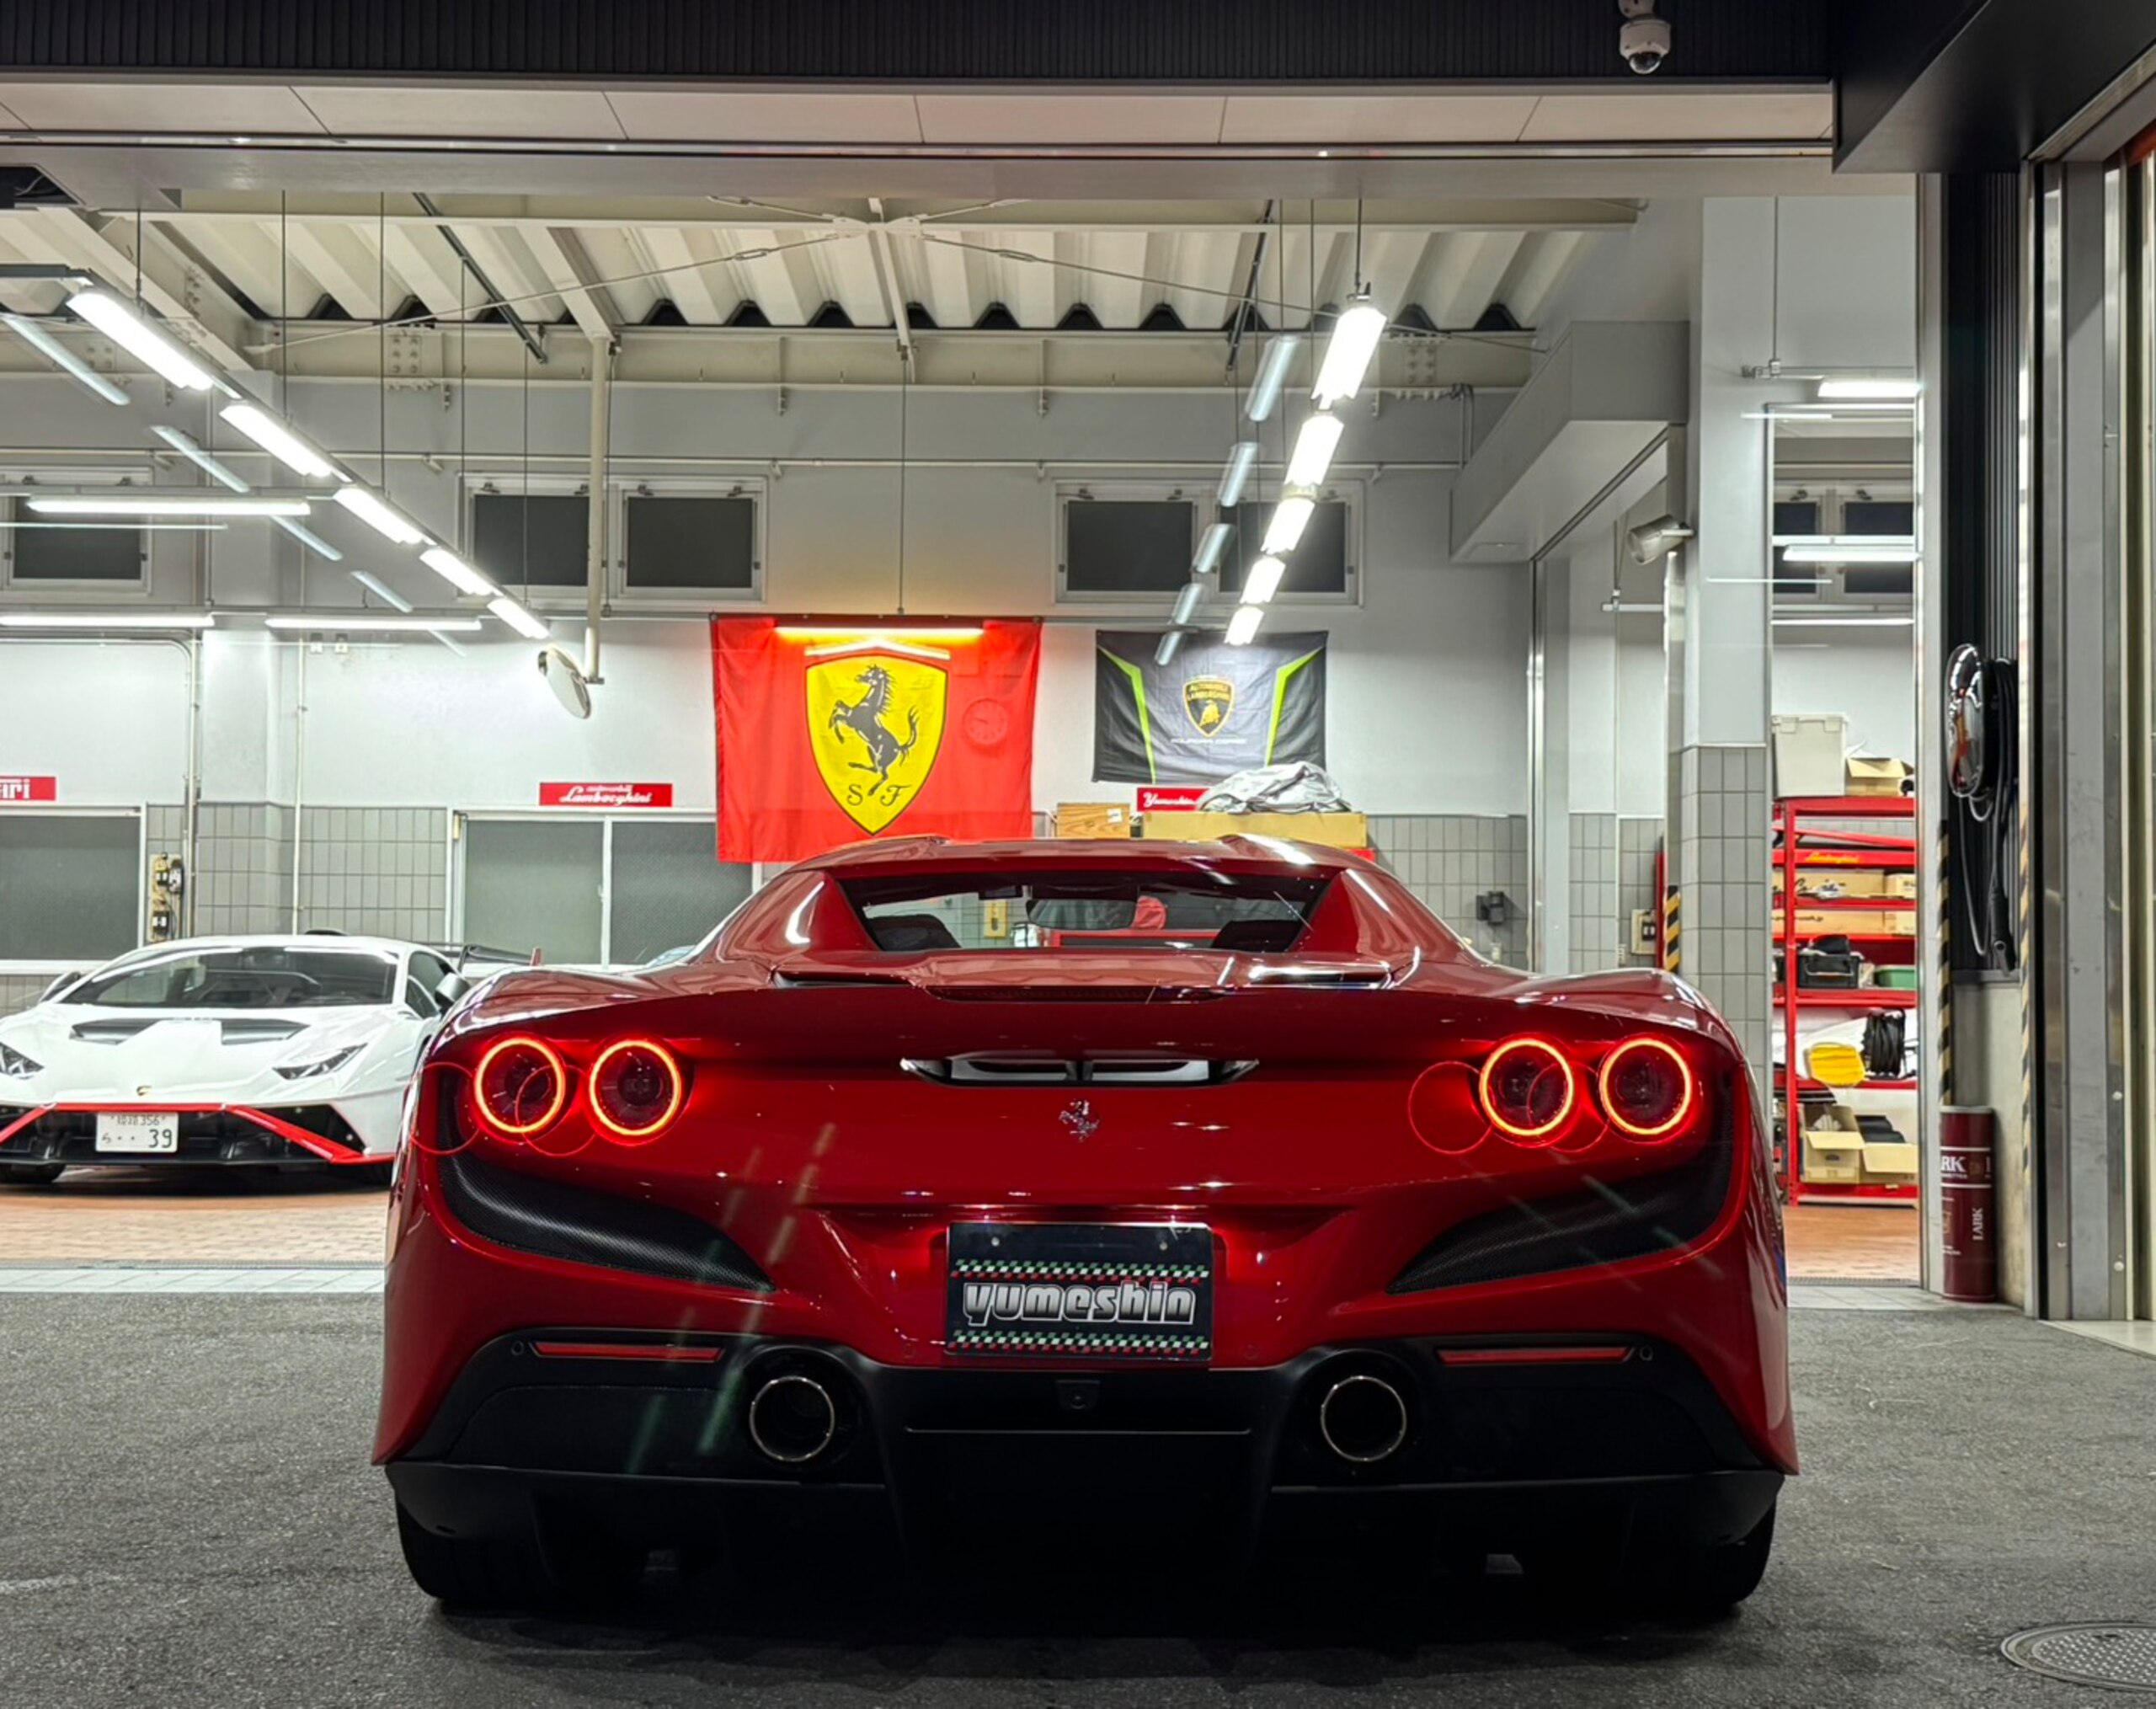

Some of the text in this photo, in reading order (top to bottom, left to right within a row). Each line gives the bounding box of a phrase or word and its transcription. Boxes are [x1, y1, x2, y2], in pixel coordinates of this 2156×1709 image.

[559, 786, 653, 806] Lamborghini
[846, 784, 912, 806] S F
[1972, 1208, 1983, 1241] LARK
[963, 1280, 1196, 1327] yumeshin
